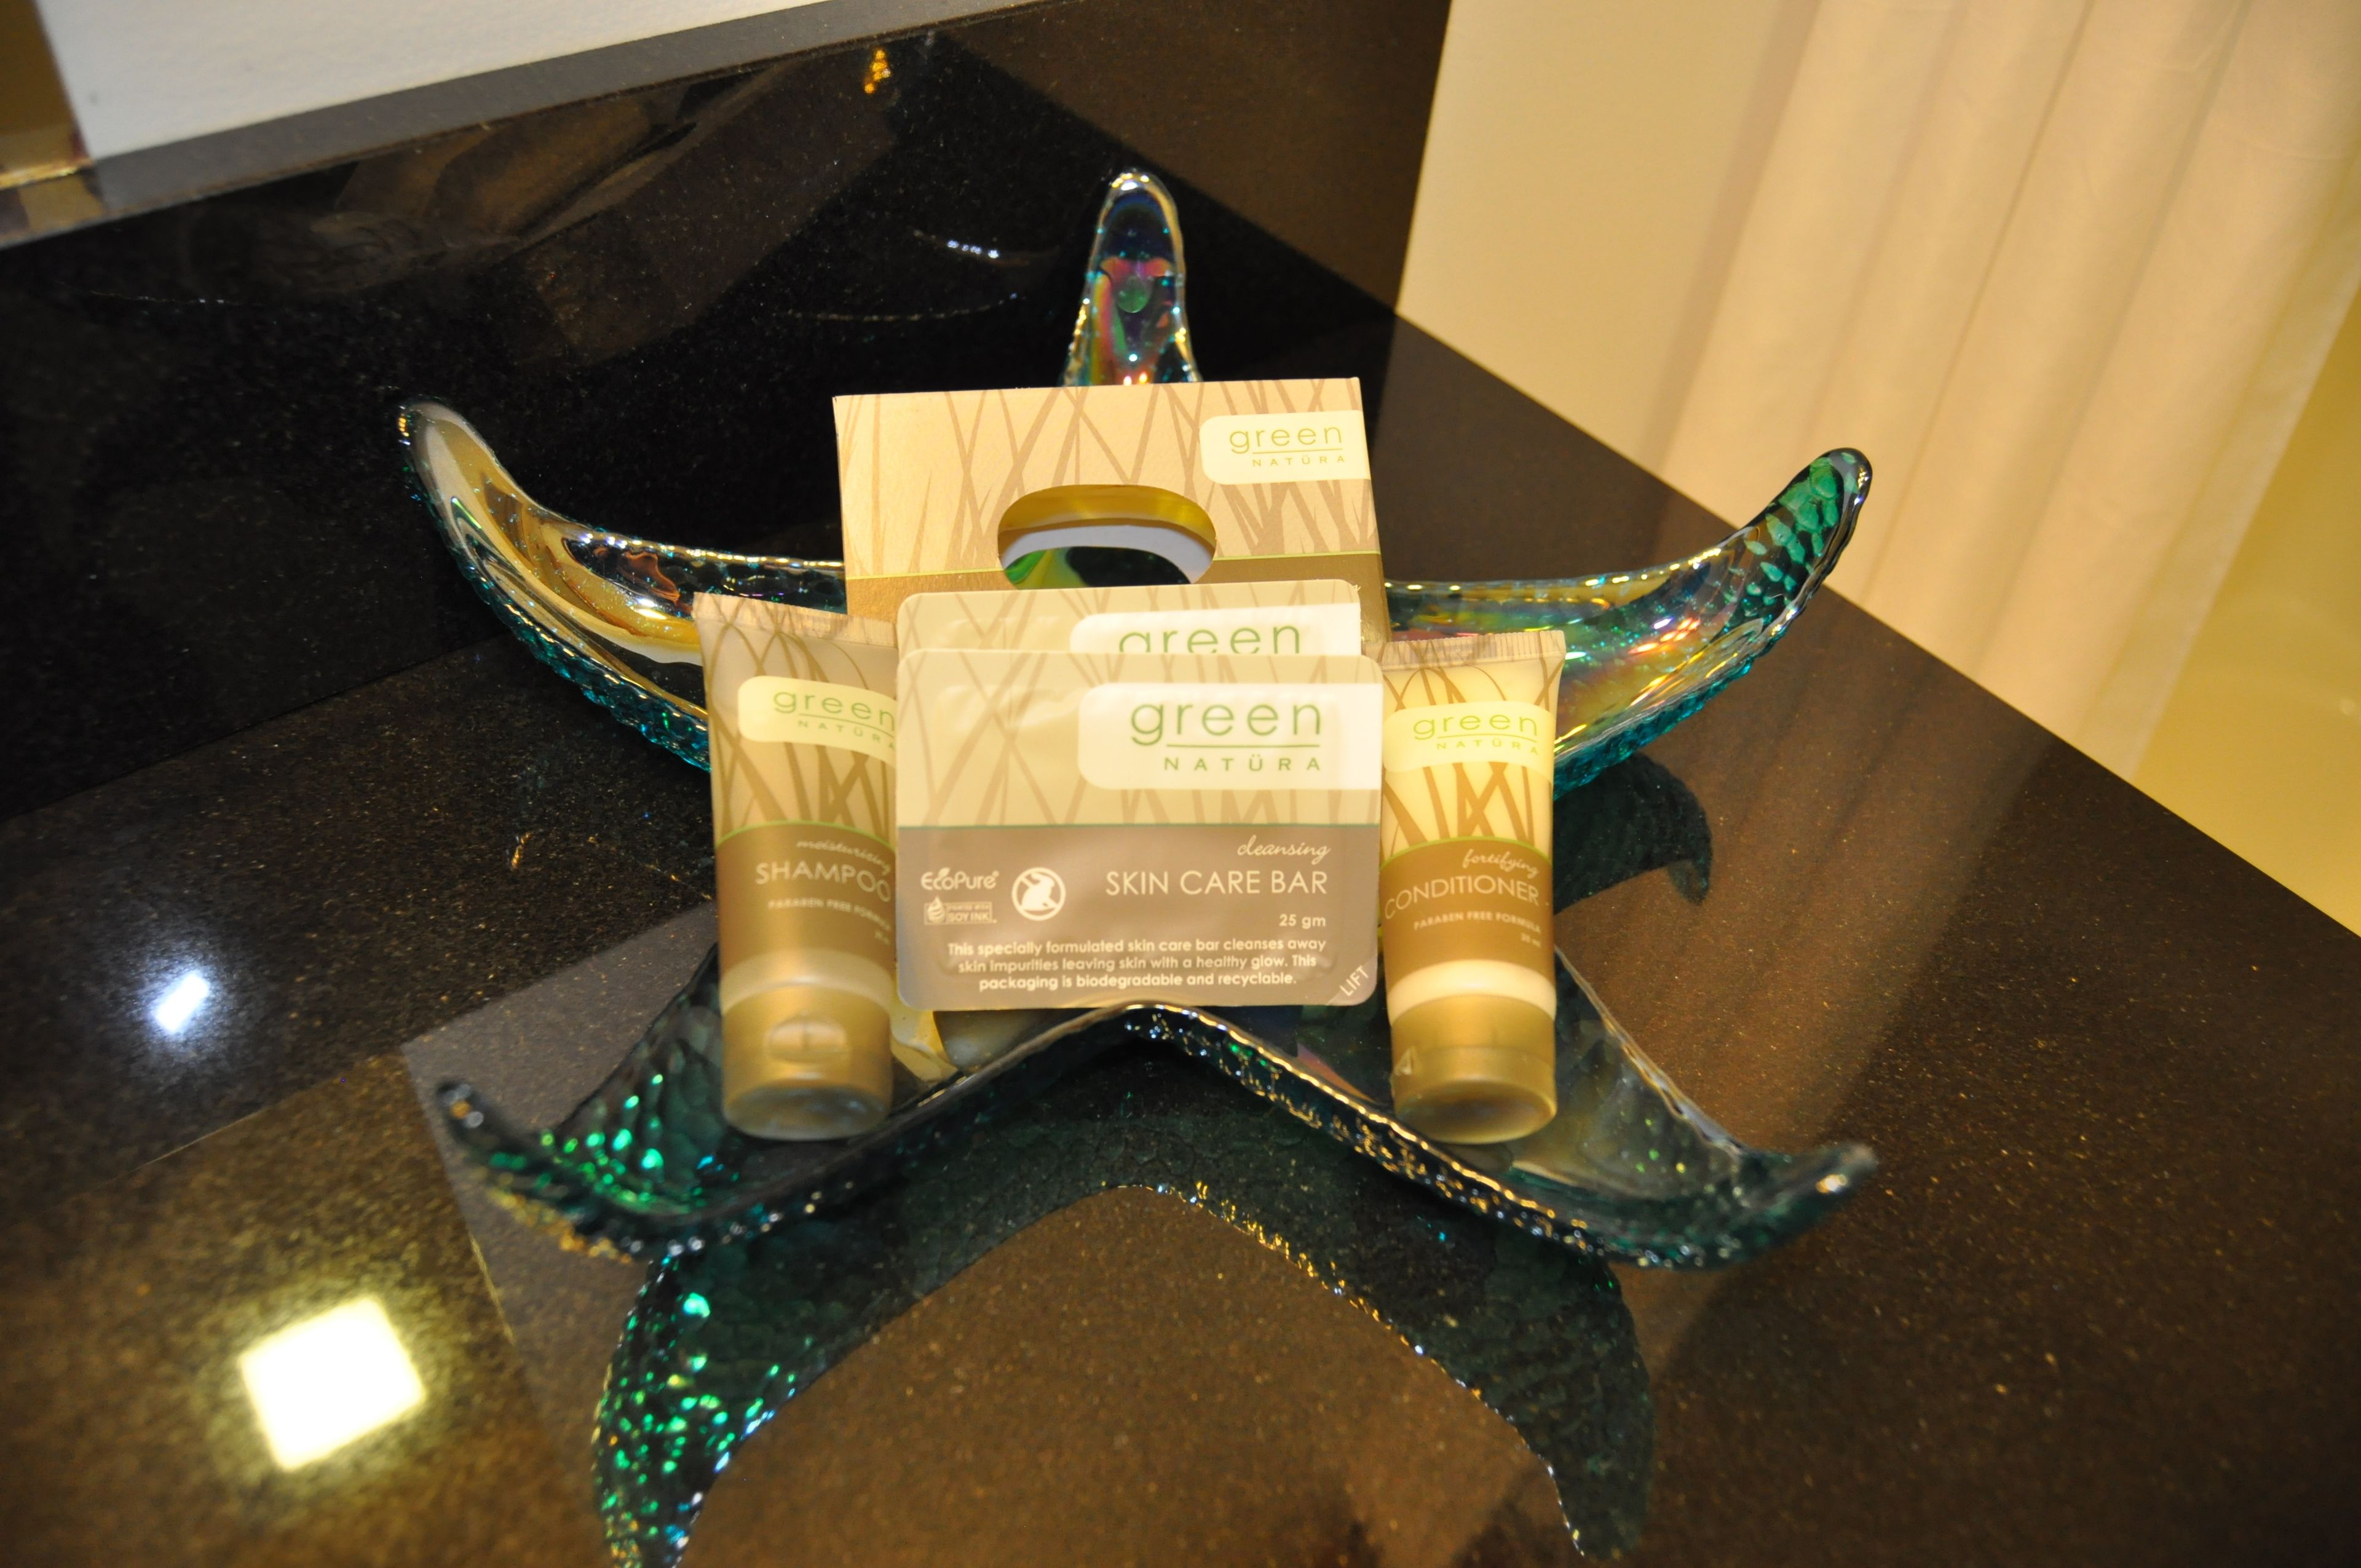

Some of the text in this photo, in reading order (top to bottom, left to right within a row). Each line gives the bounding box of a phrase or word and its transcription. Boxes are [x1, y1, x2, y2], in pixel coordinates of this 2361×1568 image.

[1230, 427, 1342, 454] green
[1252, 454, 1345, 467] NATÜRA
[773, 692, 895, 732] green
[1131, 703, 1321, 746] green
[1414, 715, 1538, 740] green
[1437, 738, 1538, 755] NATÜRA
[1165, 754, 1321, 771] NATÜRA
[1237, 835, 1331, 865] cleansing
[755, 860, 891, 903] SHAMPOO
[1106, 870, 1327, 896] SKIN CARE BAR
[1385, 875, 1540, 920] CONDITIONER
[1279, 914, 1326, 929] 25 gm
[947, 938, 1326, 958] This specially formulated skin care bar cleanses away
[959, 954, 1316, 974] skin impurities leaving skin with a healthy glow. This
[979, 971, 1297, 992] packaging is biodegradable and recyclable.
[1339, 965, 1370, 997] LIFT
